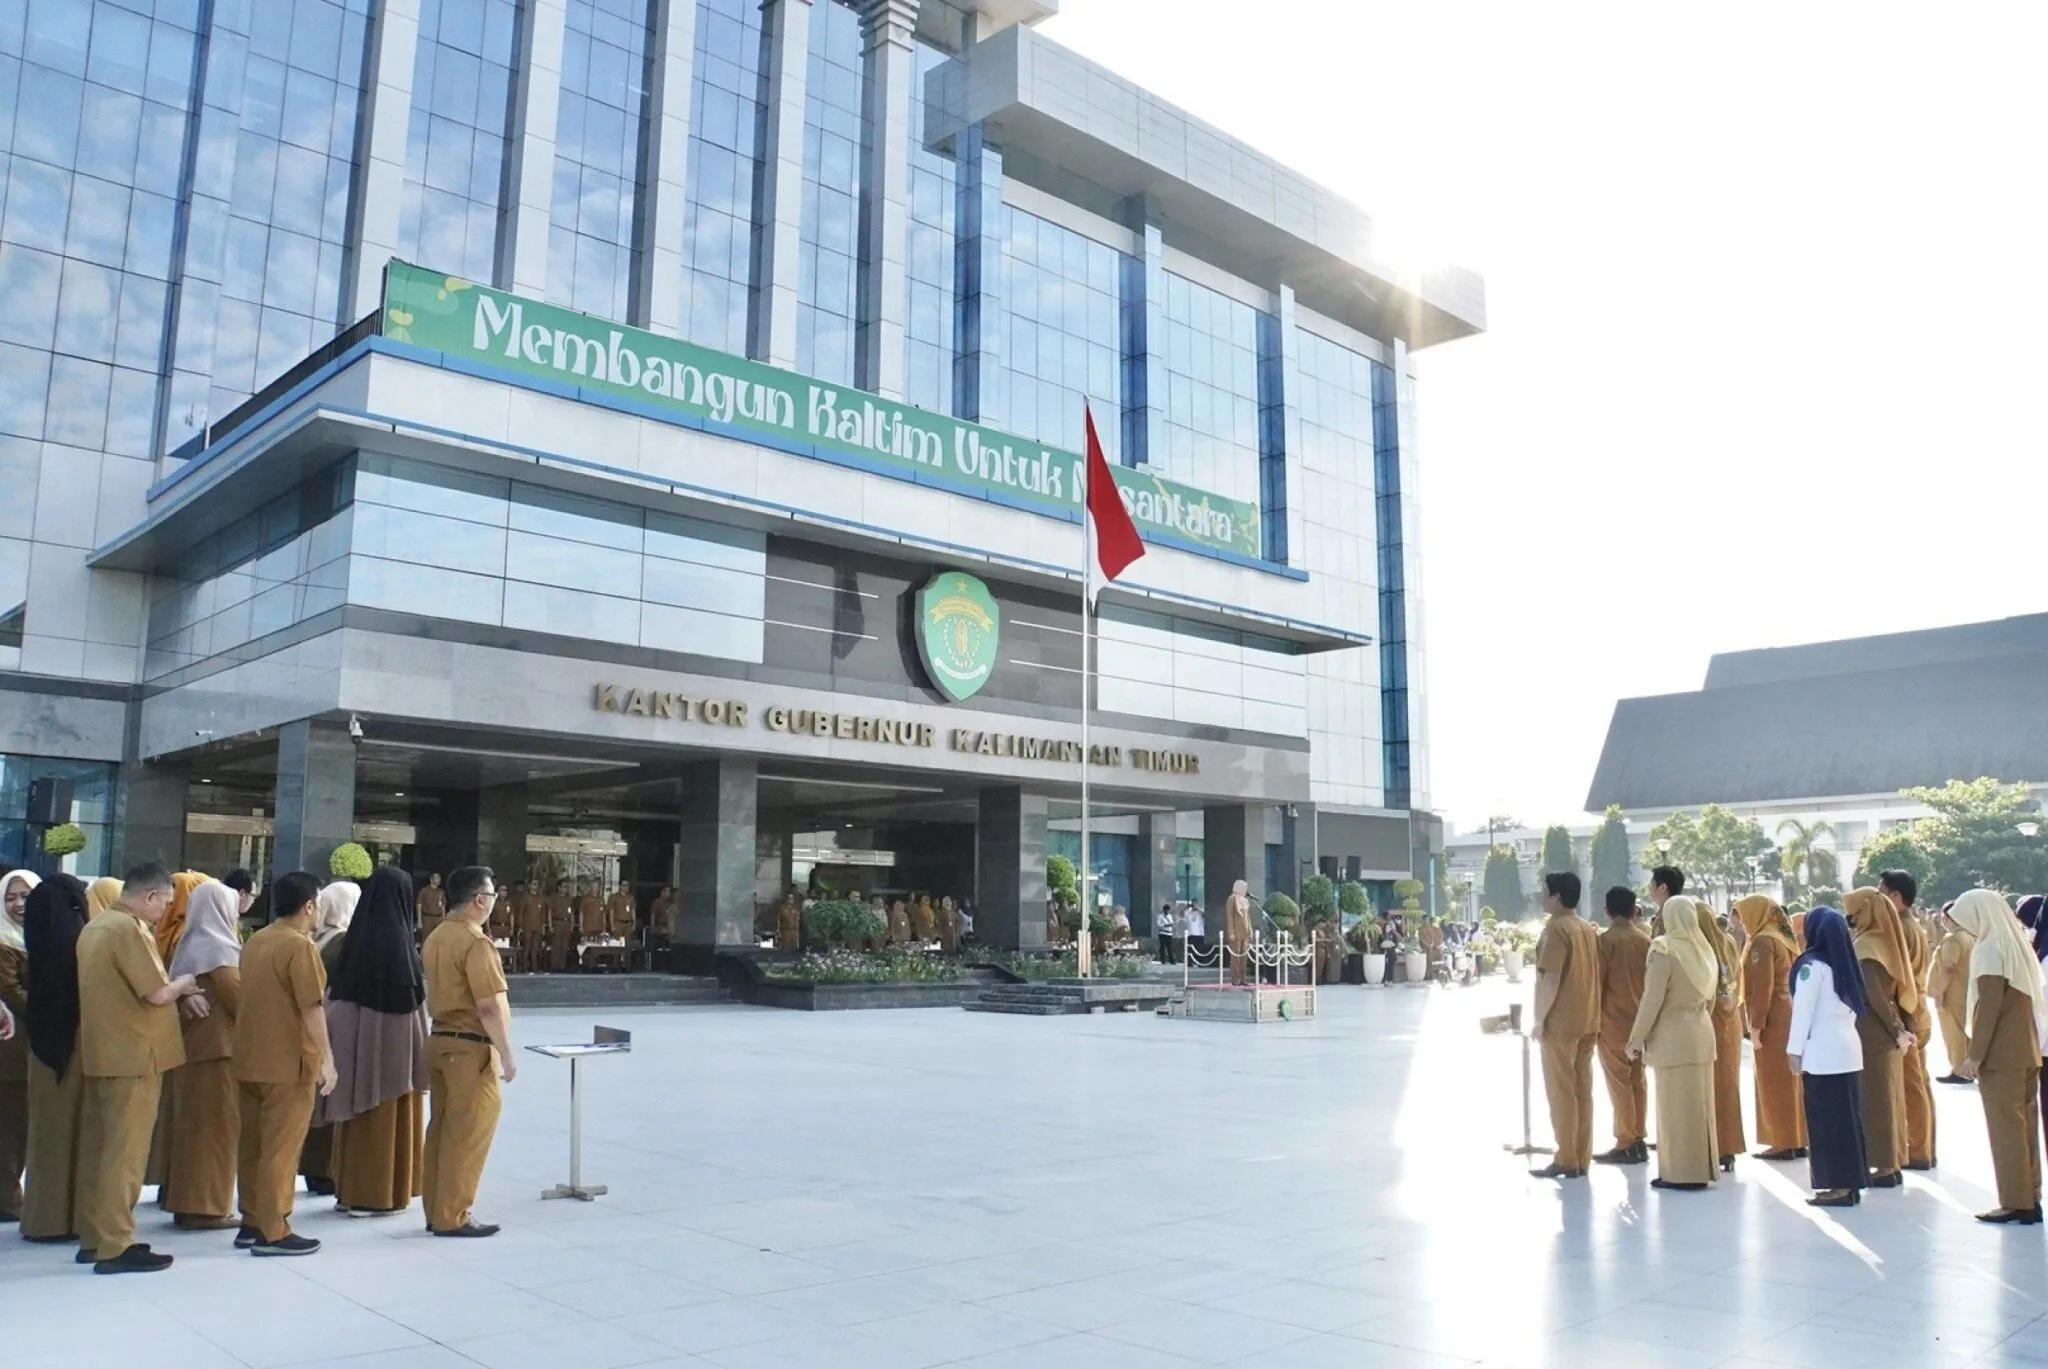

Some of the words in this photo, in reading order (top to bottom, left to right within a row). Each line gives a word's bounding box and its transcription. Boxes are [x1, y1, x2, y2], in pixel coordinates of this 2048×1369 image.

[473, 294, 795, 428] Membangun
[808, 385, 943, 468] Kaltim
[954, 426, 1062, 498] Untuk
[1072, 459, 1232, 543] Nsantara
[594, 682, 748, 728] KANTOR
[767, 705, 936, 748] GUBERNUR
[1130, 748, 1200, 773] TIMUR
